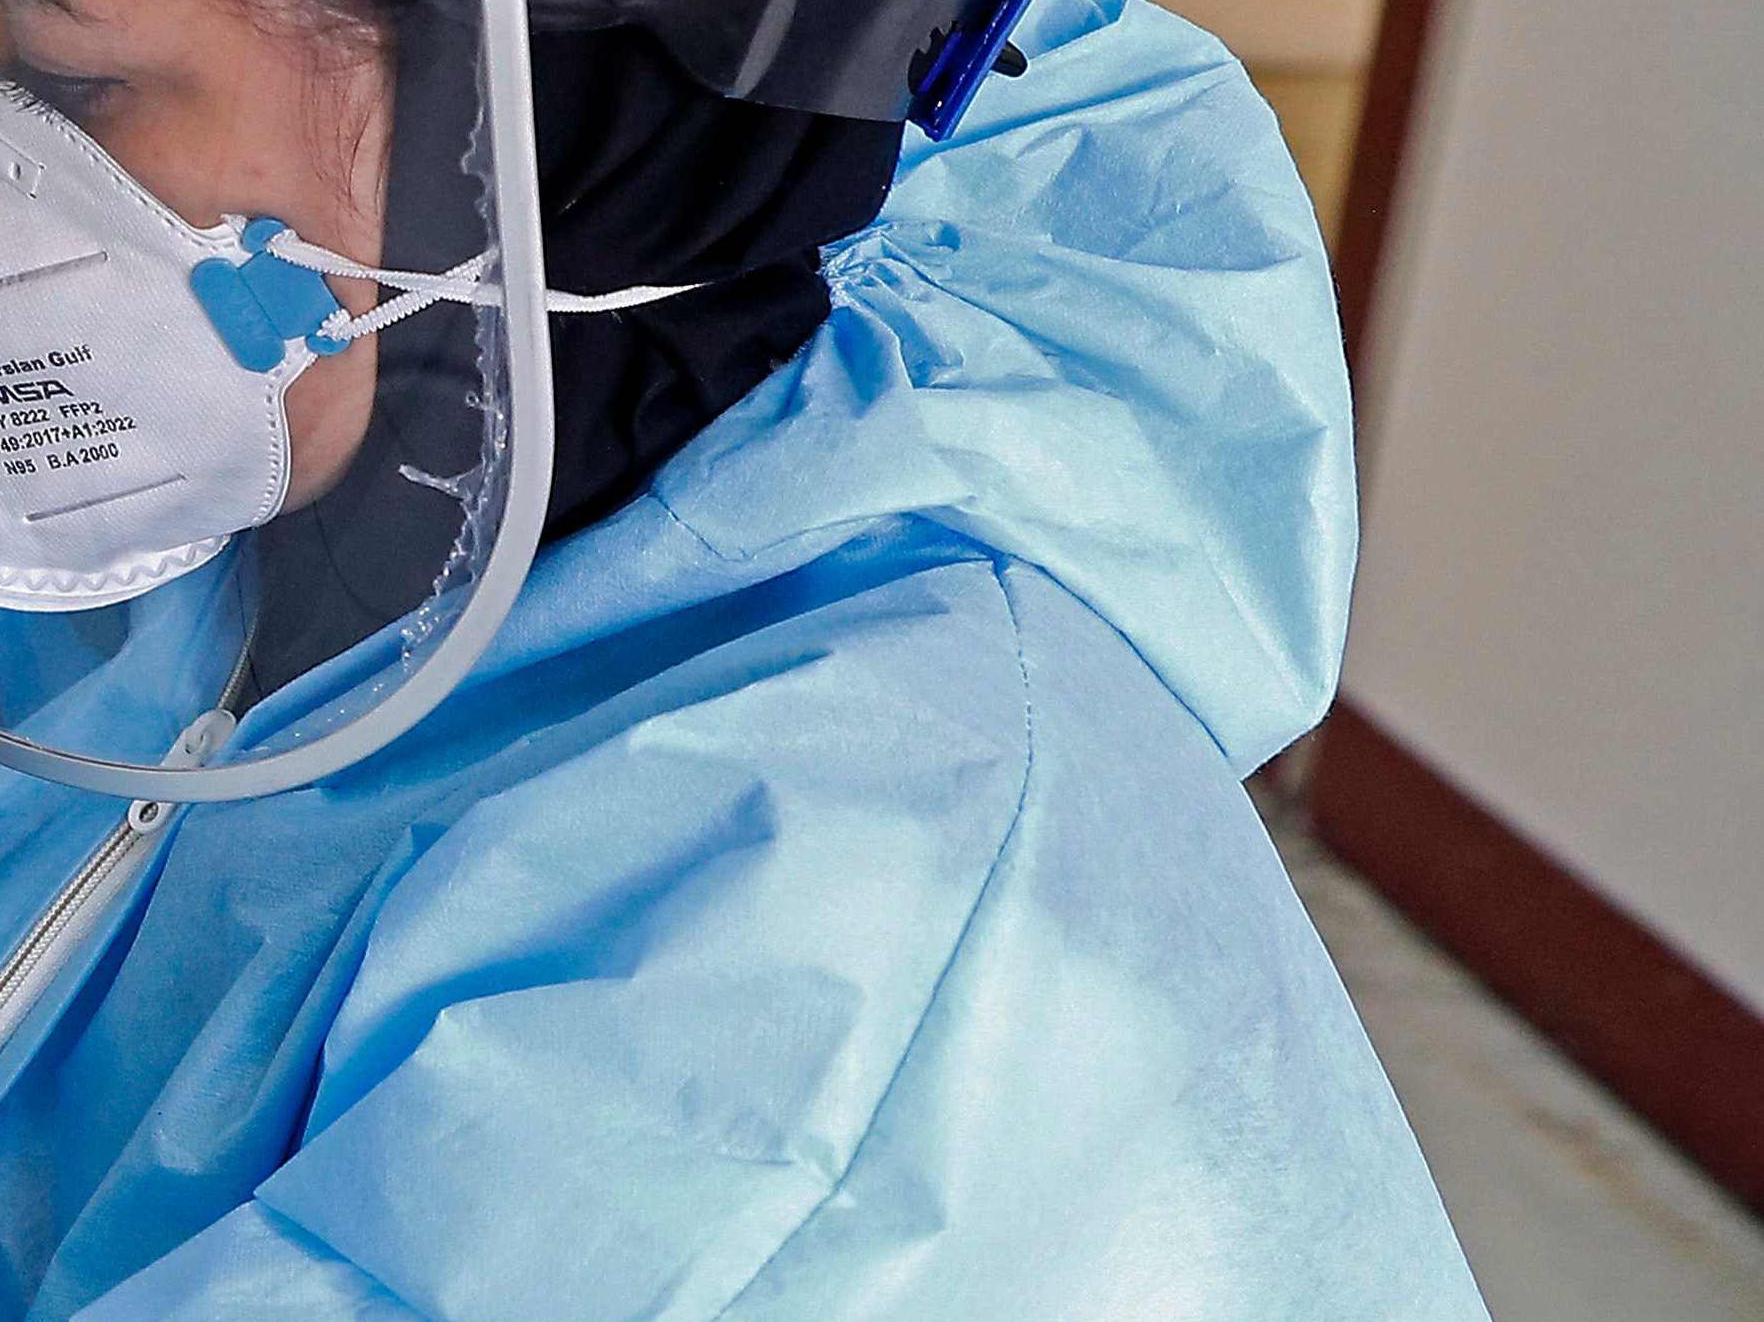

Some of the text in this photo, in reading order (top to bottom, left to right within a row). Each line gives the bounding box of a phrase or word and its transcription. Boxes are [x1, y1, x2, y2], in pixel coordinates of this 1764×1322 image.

[47, 343, 94, 368] Gulf
[9, 408, 51, 428] 8222
[59, 401, 104, 419] FFP2
[3, 459, 37, 476] N95
